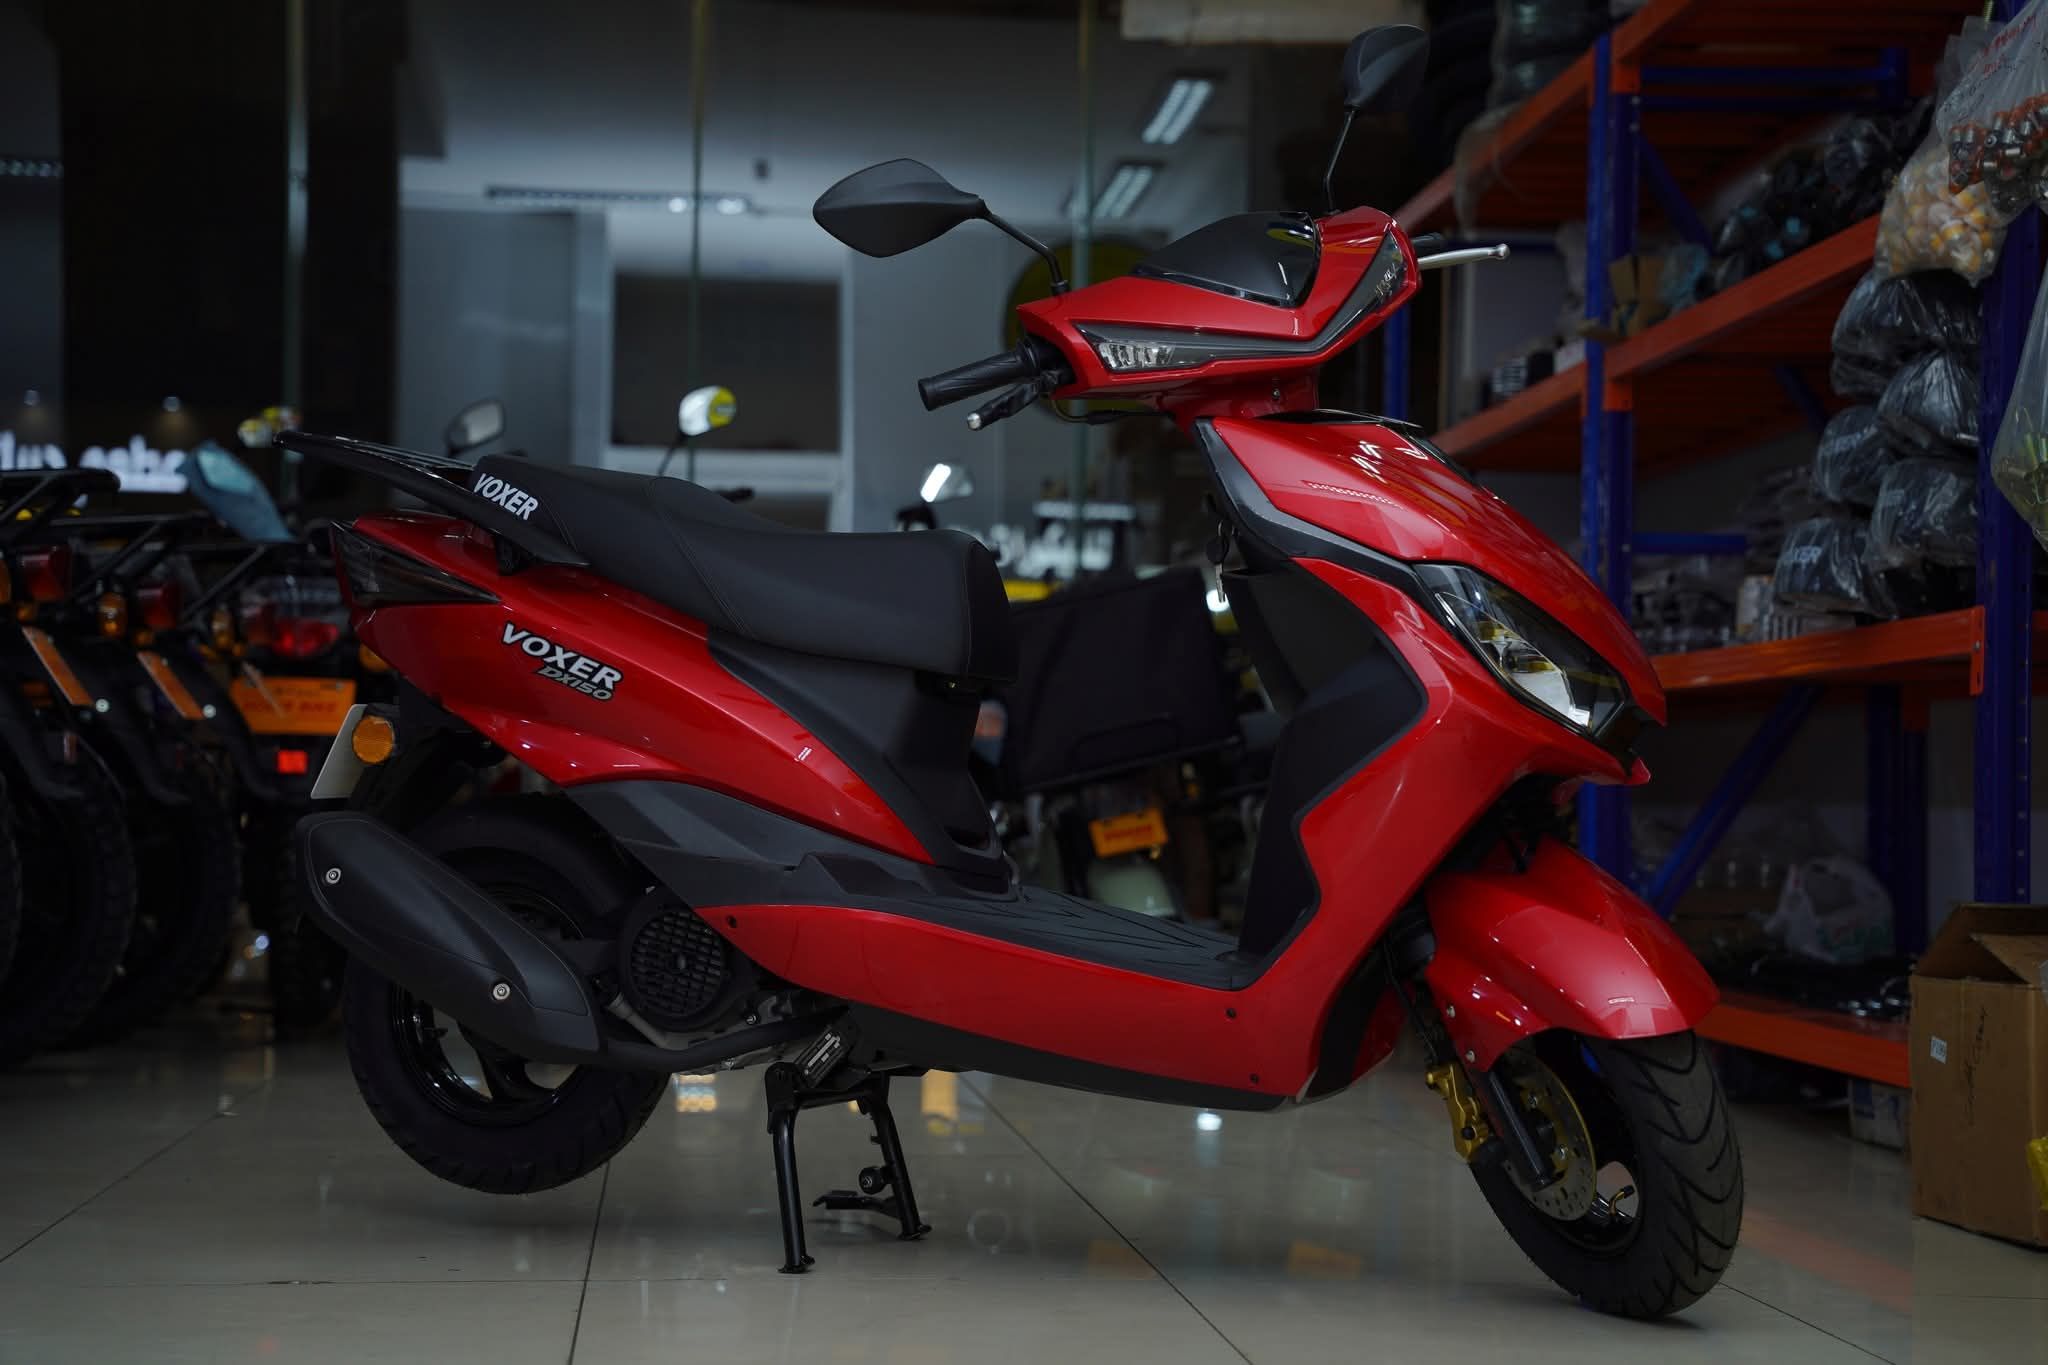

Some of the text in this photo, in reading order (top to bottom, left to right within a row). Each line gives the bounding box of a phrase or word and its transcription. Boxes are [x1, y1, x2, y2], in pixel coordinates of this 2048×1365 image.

[473, 473, 539, 520] VOXER
[502, 623, 623, 690] VOXER
[537, 667, 613, 701] DX150
